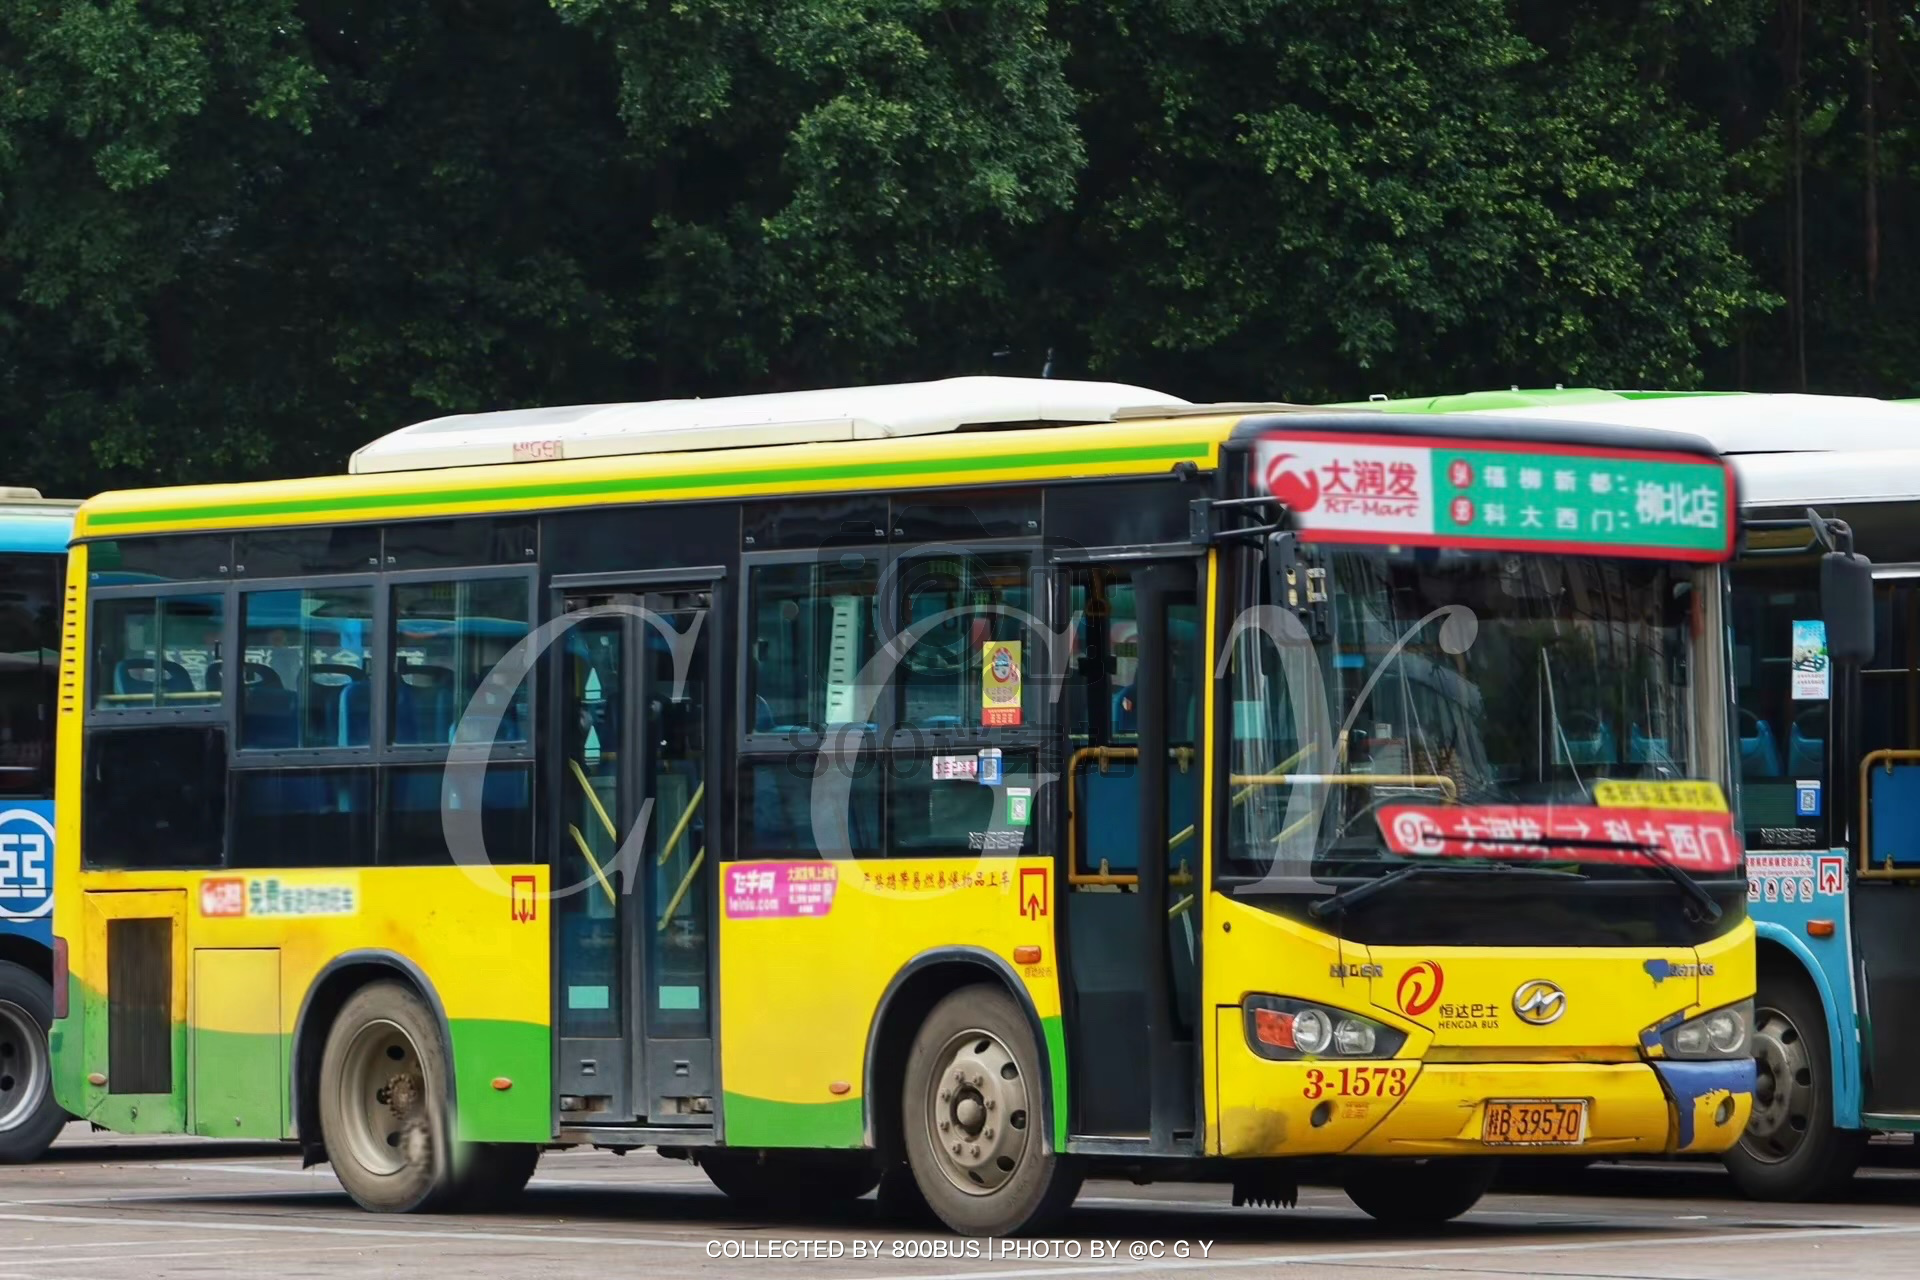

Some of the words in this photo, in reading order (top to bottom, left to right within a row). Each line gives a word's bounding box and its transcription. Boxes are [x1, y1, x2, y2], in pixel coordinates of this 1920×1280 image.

[1321, 458, 1417, 496] 大润发
[1323, 498, 1419, 518] RT-Mart
[1635, 480, 1719, 529] 柳北店
[1438, 1020, 1478, 1029] HENGDA
[1481, 1020, 1499, 1029] BUS
[1439, 1004, 1499, 1019] 恒达巴士
[1303, 1067, 1408, 1100] 3-1573
